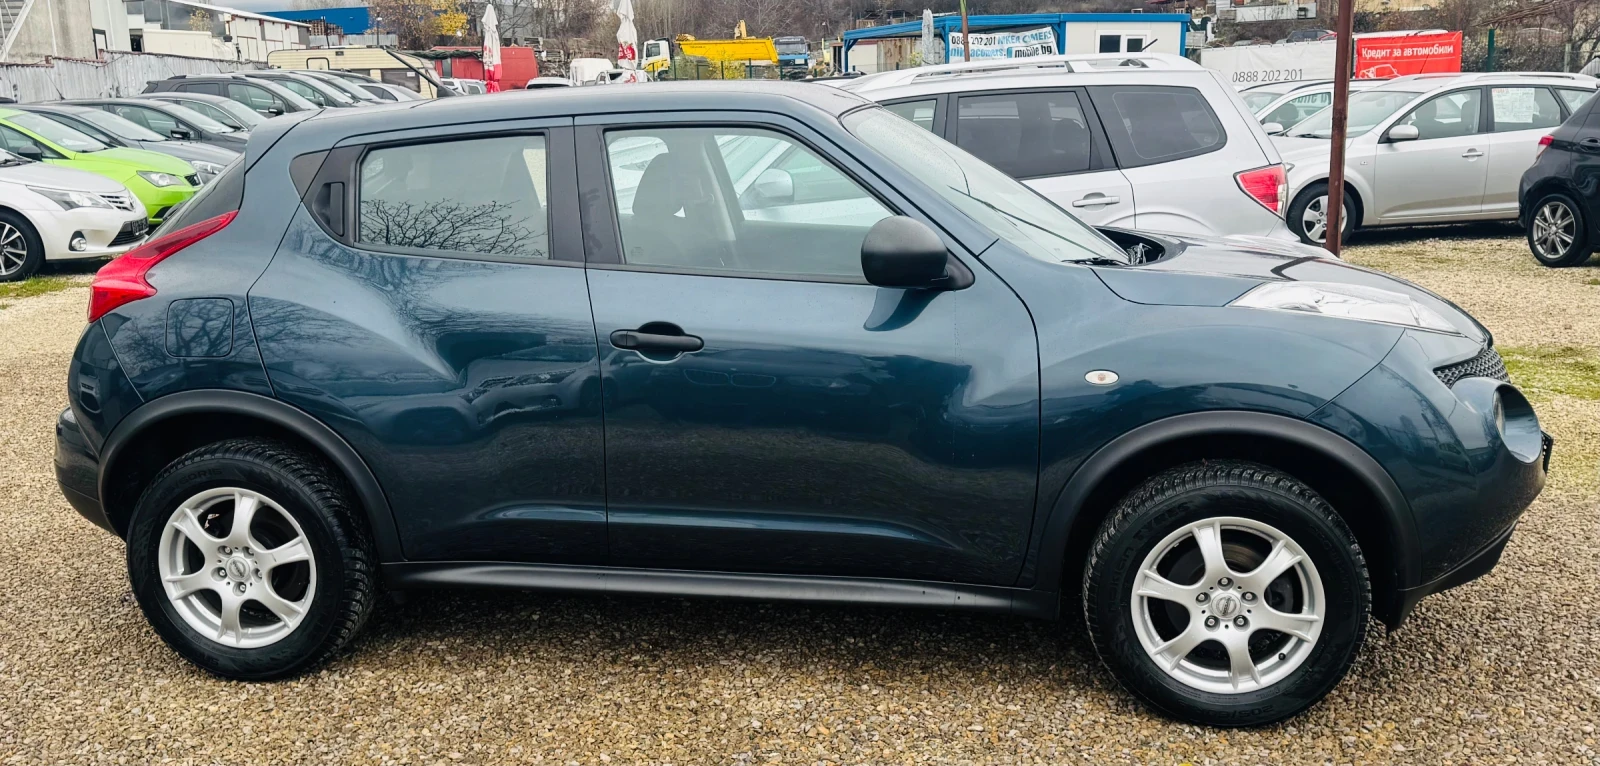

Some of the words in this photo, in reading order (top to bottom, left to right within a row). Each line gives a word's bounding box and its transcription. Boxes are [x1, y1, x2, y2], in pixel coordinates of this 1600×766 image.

[1362, 47, 1390, 59] Кредит
[1392, 48, 1401, 57] за
[1403, 44, 1453, 56] автомобили
[1232, 70, 1258, 82] 0888
[1261, 69, 1281, 82] 202
[1283, 68, 1303, 80] 201
